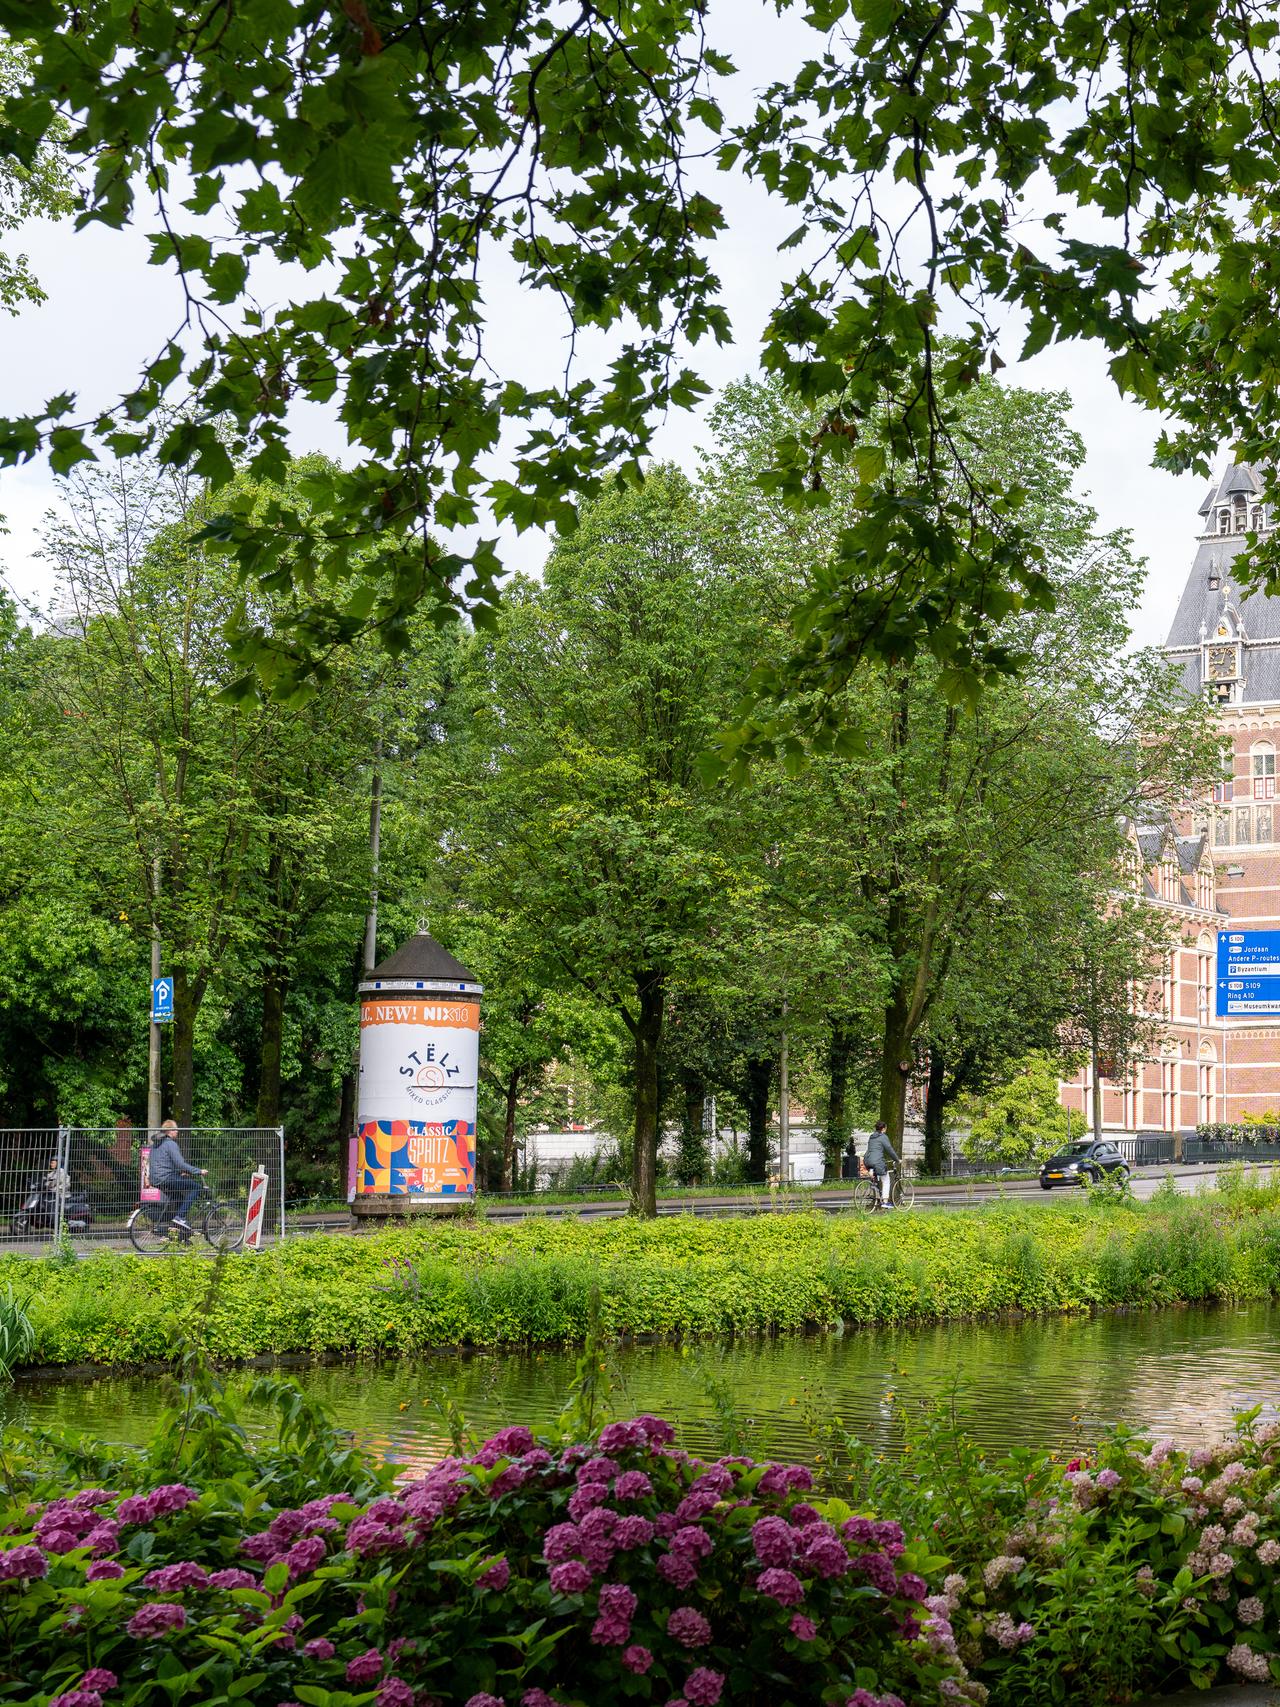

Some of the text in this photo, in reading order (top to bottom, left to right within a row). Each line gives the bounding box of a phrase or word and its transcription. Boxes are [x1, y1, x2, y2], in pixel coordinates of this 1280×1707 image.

[376, 1006, 417, 1021] NEW!
[424, 1006, 469, 1023] NIX18
[399, 1043, 460, 1078] STËLZ
[406, 1086, 424, 1104] MIXED
[407, 1126, 452, 1137] CLASSIC
[409, 1137, 449, 1164] SPRITZ
[422, 1168, 435, 1183] 63
